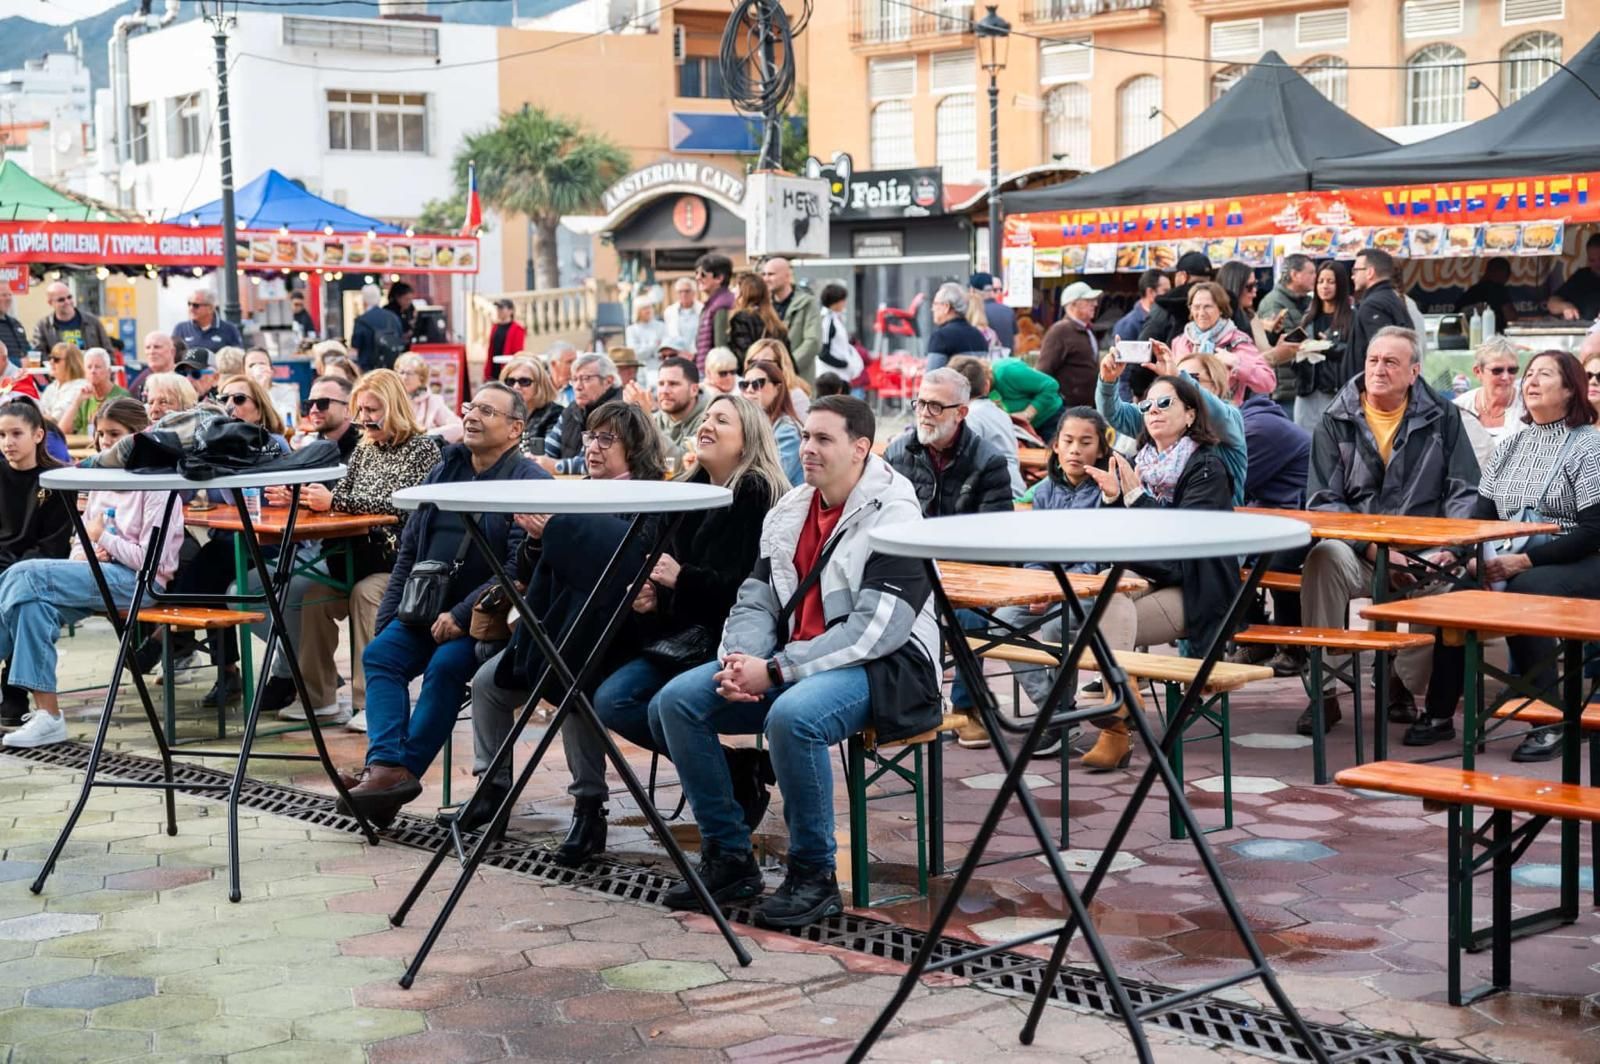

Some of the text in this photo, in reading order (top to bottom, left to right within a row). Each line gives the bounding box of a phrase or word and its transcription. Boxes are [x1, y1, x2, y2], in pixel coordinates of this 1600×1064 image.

[605, 162, 743, 213] AMSTERDAM CAFE
[11, 228, 49, 252] TÍPICA
[51, 233, 100, 253] CHILENA
[110, 234, 157, 255] TYPICAL
[159, 236, 204, 255] CHILEAN
